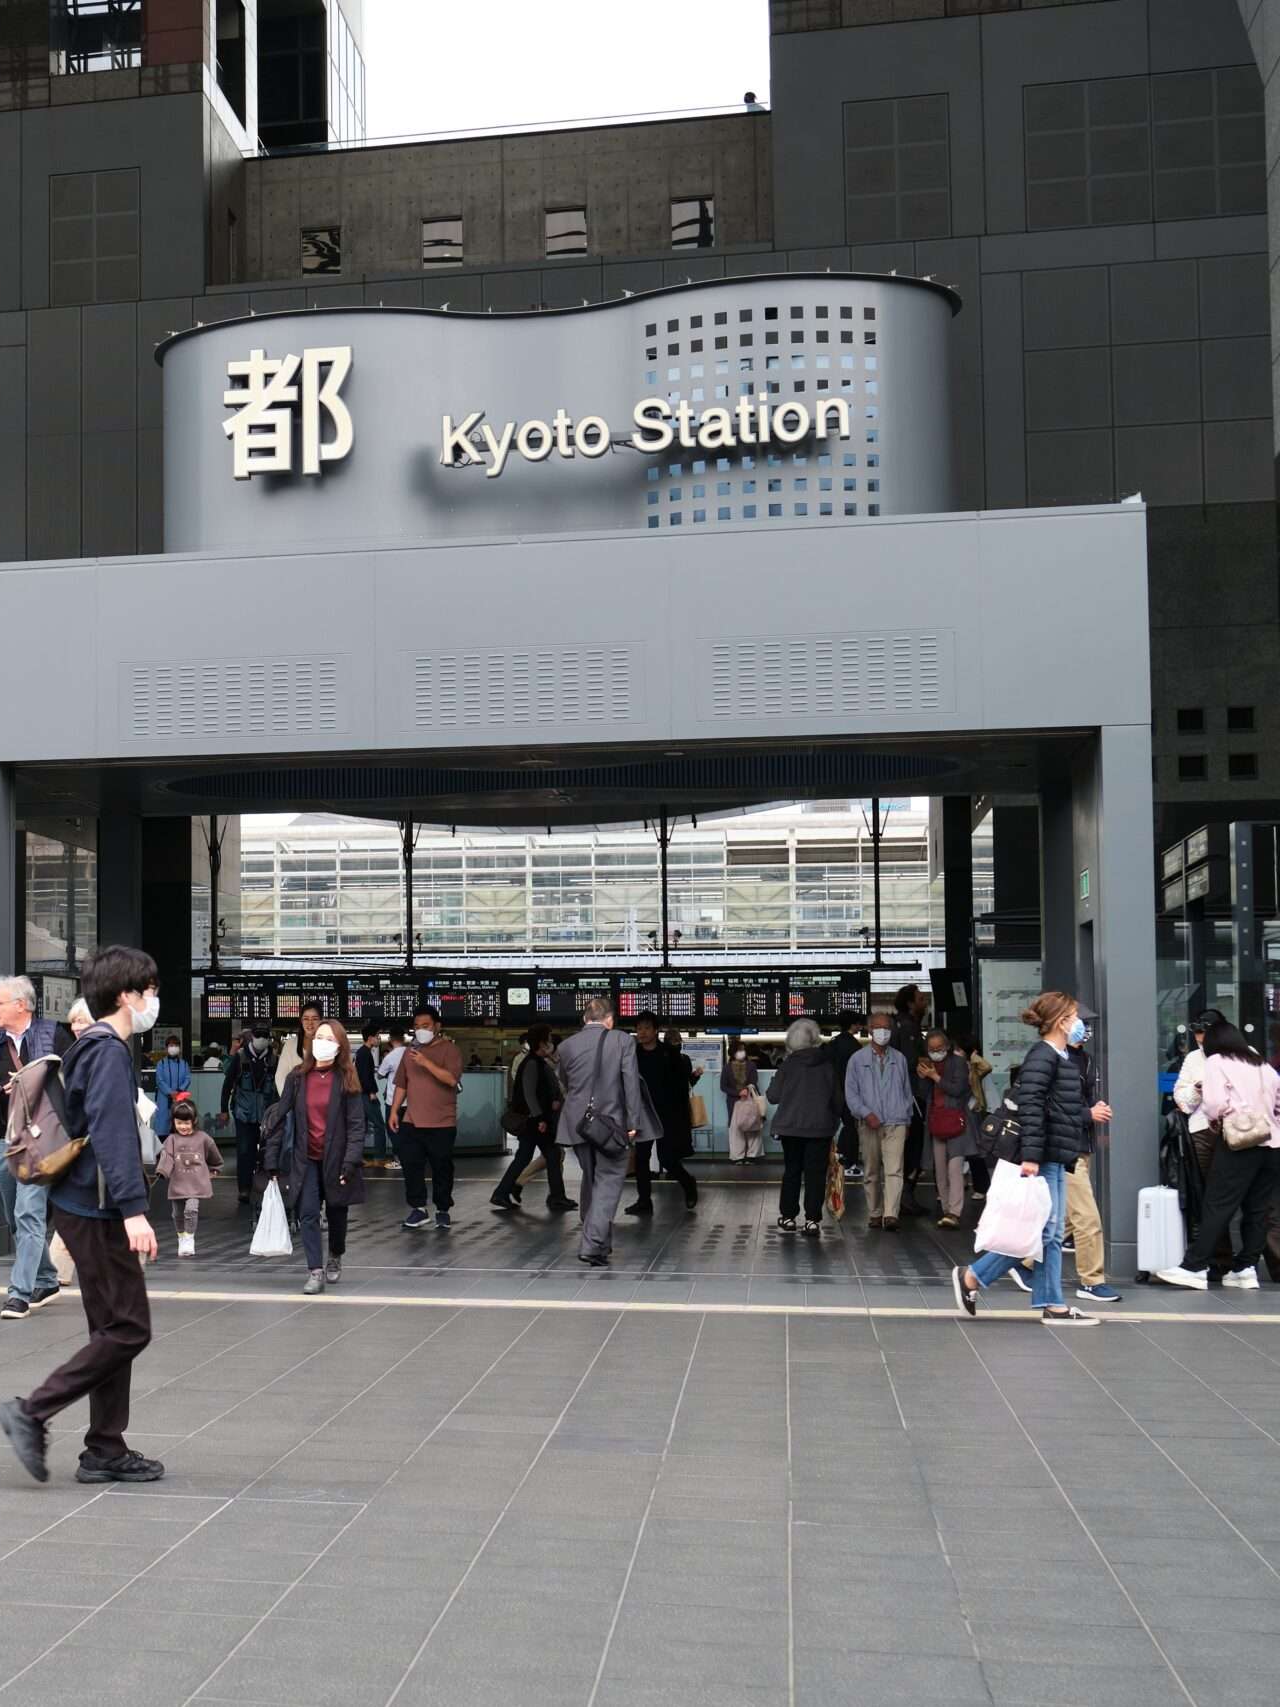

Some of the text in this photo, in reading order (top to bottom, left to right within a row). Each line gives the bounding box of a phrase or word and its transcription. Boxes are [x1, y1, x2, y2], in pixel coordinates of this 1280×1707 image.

[221, 345, 852, 481] 都 Kyoto Station
